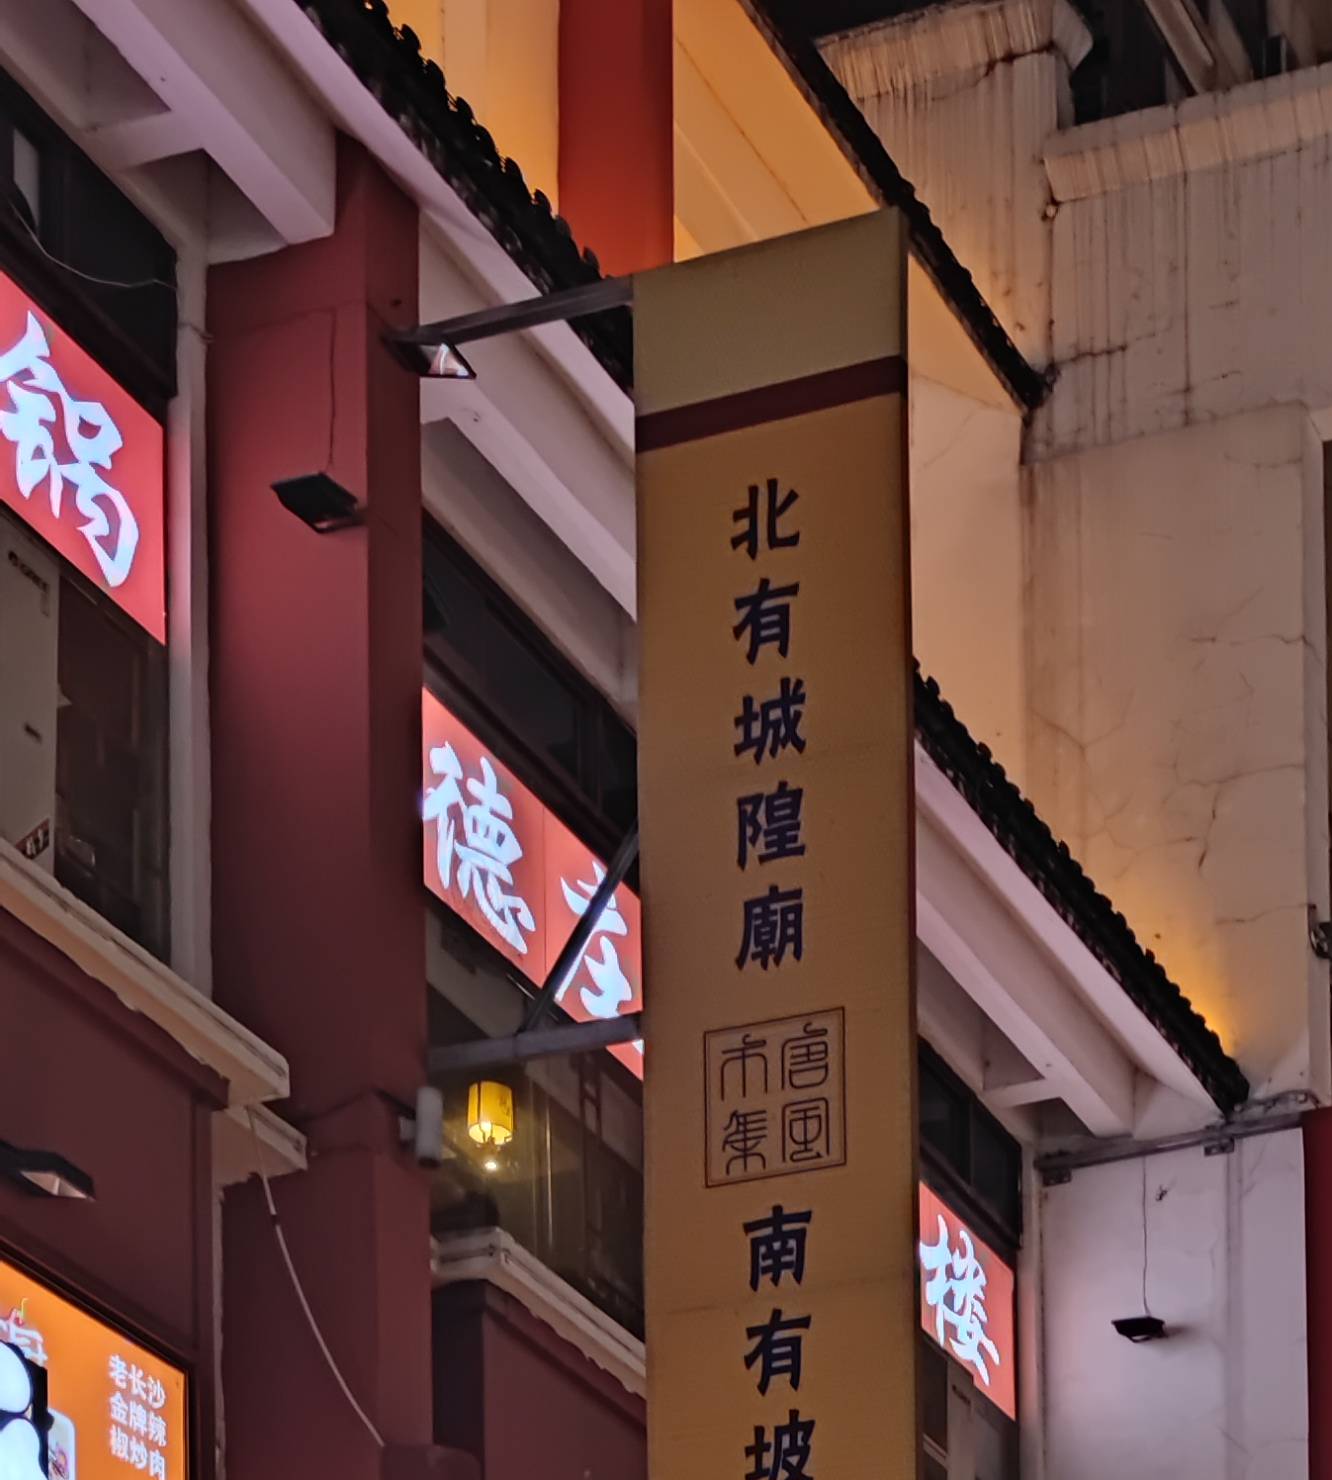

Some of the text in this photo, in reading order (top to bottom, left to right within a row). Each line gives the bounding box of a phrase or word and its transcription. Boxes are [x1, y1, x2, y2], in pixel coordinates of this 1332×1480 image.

[730, 477, 808, 971] 北有城隍廟
[108, 1355, 167, 1408] 老长沙
[109, 1394, 168, 1448] 金牌辣
